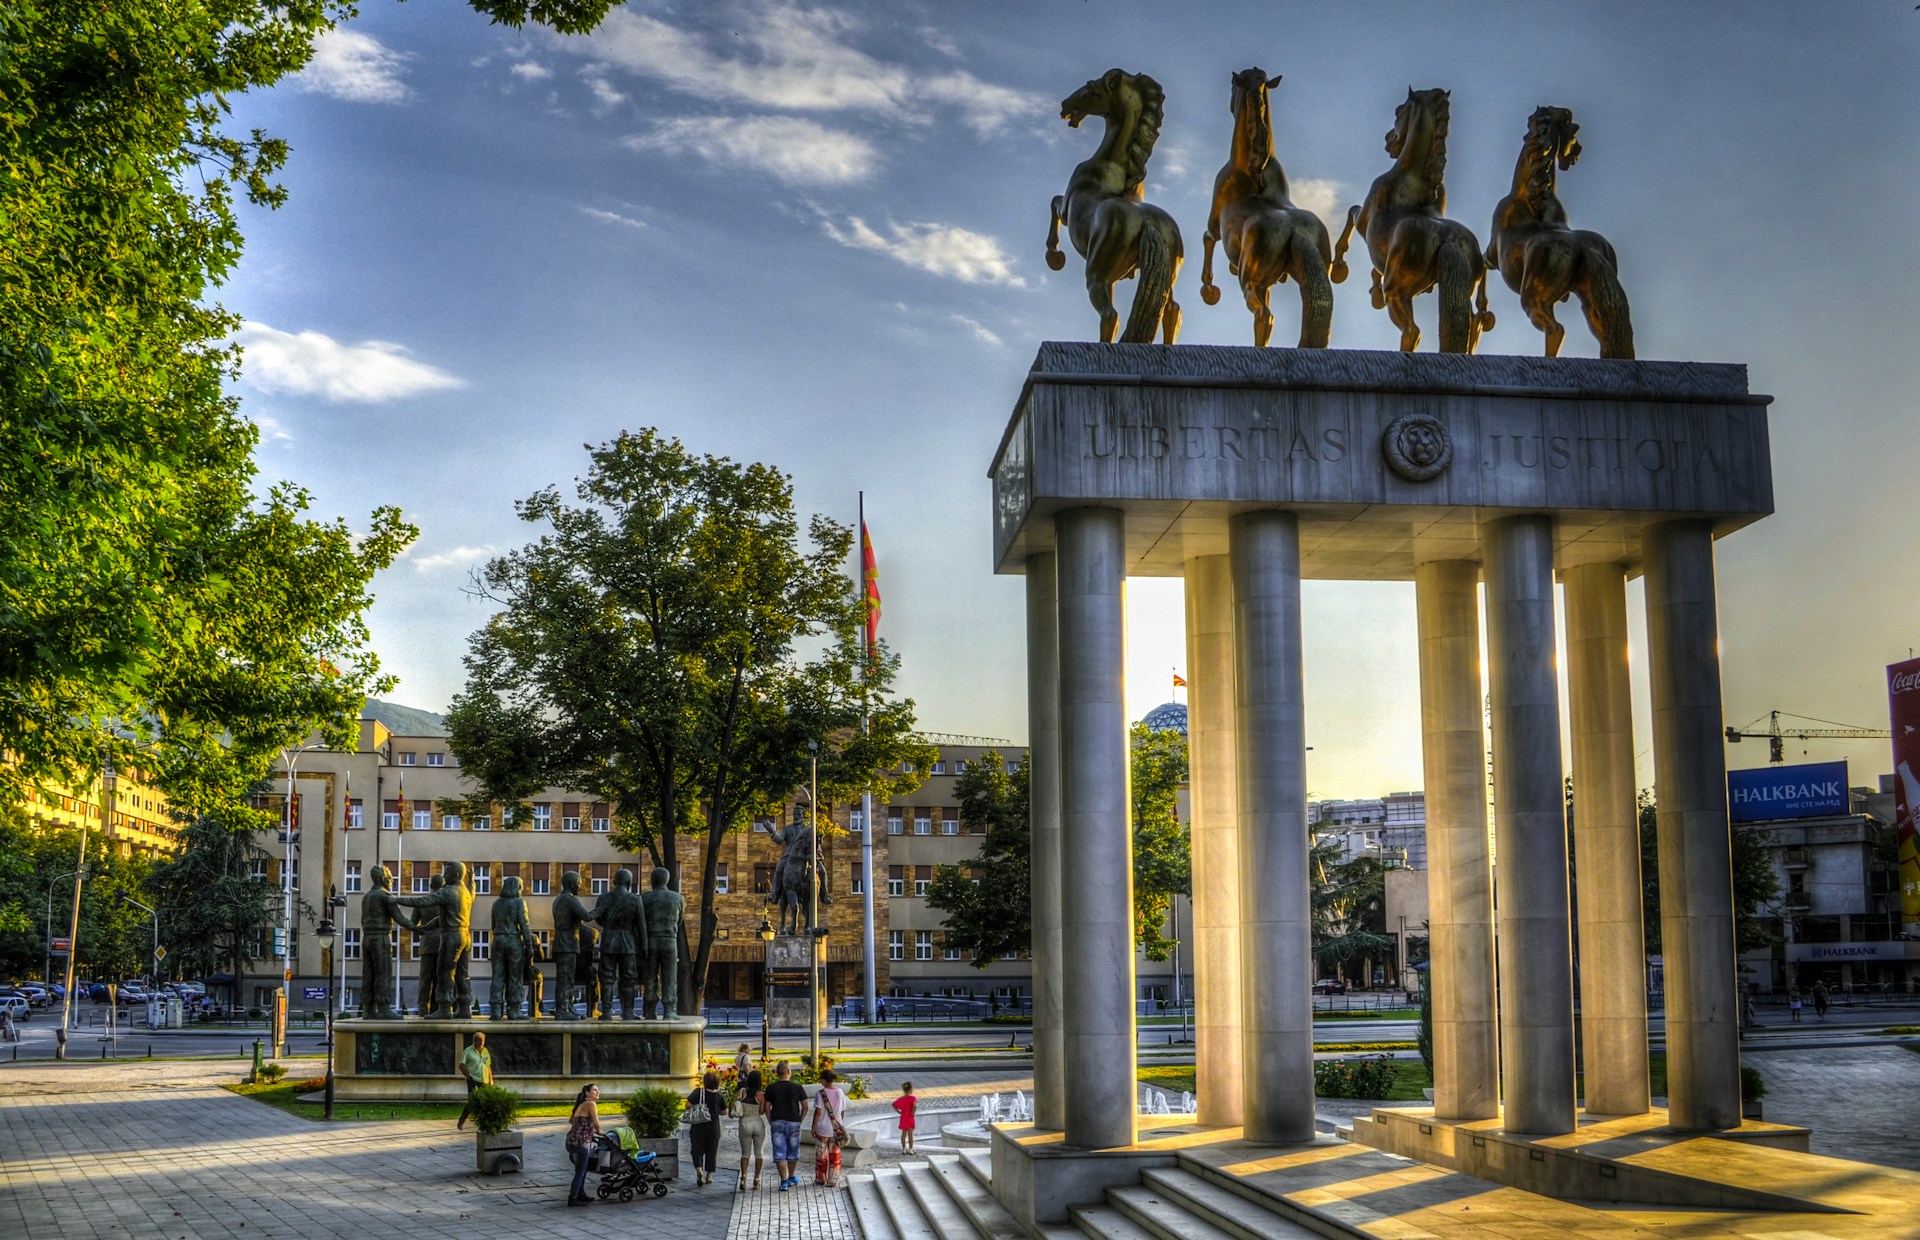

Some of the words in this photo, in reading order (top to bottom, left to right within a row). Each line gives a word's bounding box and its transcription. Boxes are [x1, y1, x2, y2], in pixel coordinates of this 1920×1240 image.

[1083, 424, 1347, 463] LIBERTAS
[1483, 434, 1724, 474] JUSTICIA
[1733, 781, 1840, 803] HALKBANK
[1826, 799, 1841, 807] РЕД
[1823, 946, 1878, 956] HALKBANK
